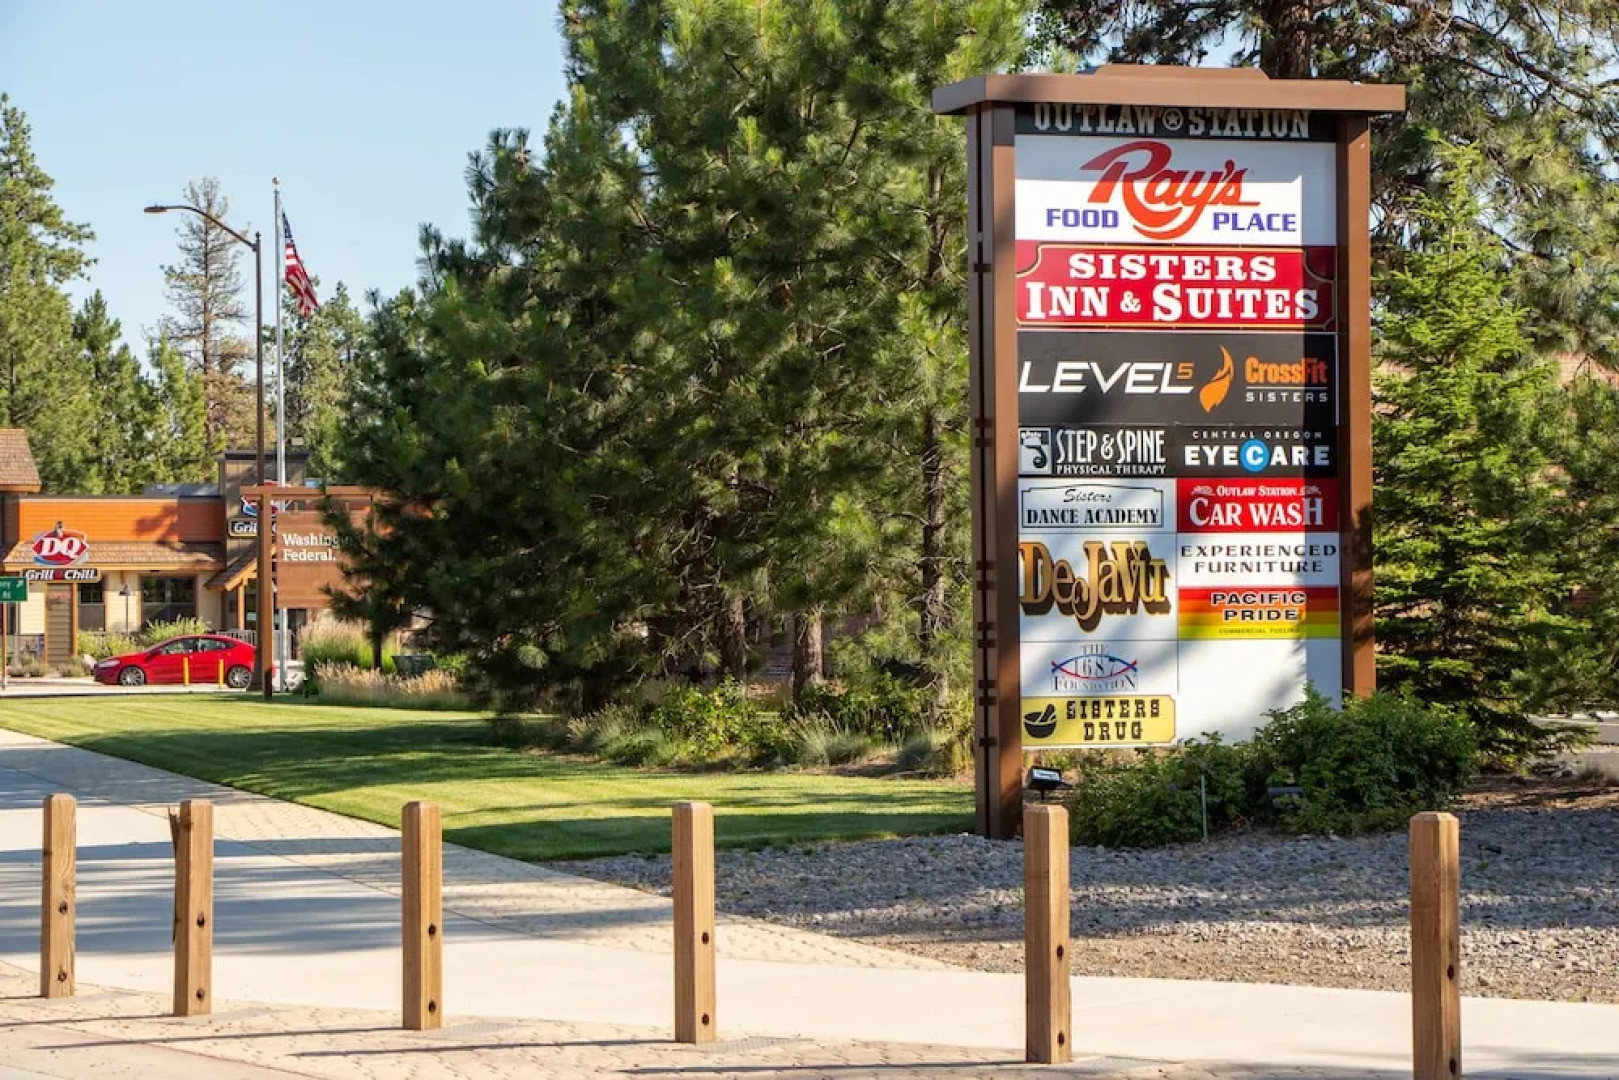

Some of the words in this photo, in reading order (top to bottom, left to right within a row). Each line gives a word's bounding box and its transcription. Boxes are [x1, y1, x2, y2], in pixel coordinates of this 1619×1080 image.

[1033, 102, 1156, 134] OUTLAW
[1187, 107, 1311, 138] STATION
[1080, 140, 1261, 240] Ray's
[1046, 208, 1119, 228] FOOD
[1213, 212, 1297, 232] PLACE
[1069, 253, 1277, 281] SISTERS
[1025, 282, 1109, 319] INN
[1119, 291, 1141, 313] &
[1152, 283, 1319, 321] SUITES
[1244, 357, 1329, 383] CrossFit
[1245, 392, 1329, 403] SISTERS
[1192, 431, 1256, 439] CENTRAL
[1263, 431, 1323, 439] OREGON
[1056, 429, 1097, 463] STEP
[1100, 432, 1116, 462] &
[1115, 429, 1167, 464] SPINE
[1184, 445, 1330, 467] EYECARE
[1056, 465, 1113, 474] PHYSICAL
[1115, 465, 1167, 475] THERAPY
[1062, 488, 1112, 504] Sisters
[1026, 508, 1079, 525] DANCE
[1084, 508, 1160, 525] ACADEMY
[1189, 497, 1242, 526] CAR
[1248, 497, 1323, 527] WASH
[40, 536, 81, 560] DQ
[282, 548, 337, 561] Federal.
[1180, 545, 1337, 558] EXPERIENCED
[25, 569, 55, 580] Grill
[64, 569, 95, 580] Chill
[1194, 561, 1324, 573] FURNITURE
[1211, 592, 1306, 606] PACIFIC
[1223, 609, 1300, 622] PRIDE
[1081, 643, 1110, 655] THE
[1066, 700, 1160, 719] SISTERS
[1083, 721, 1143, 741] DRUG
